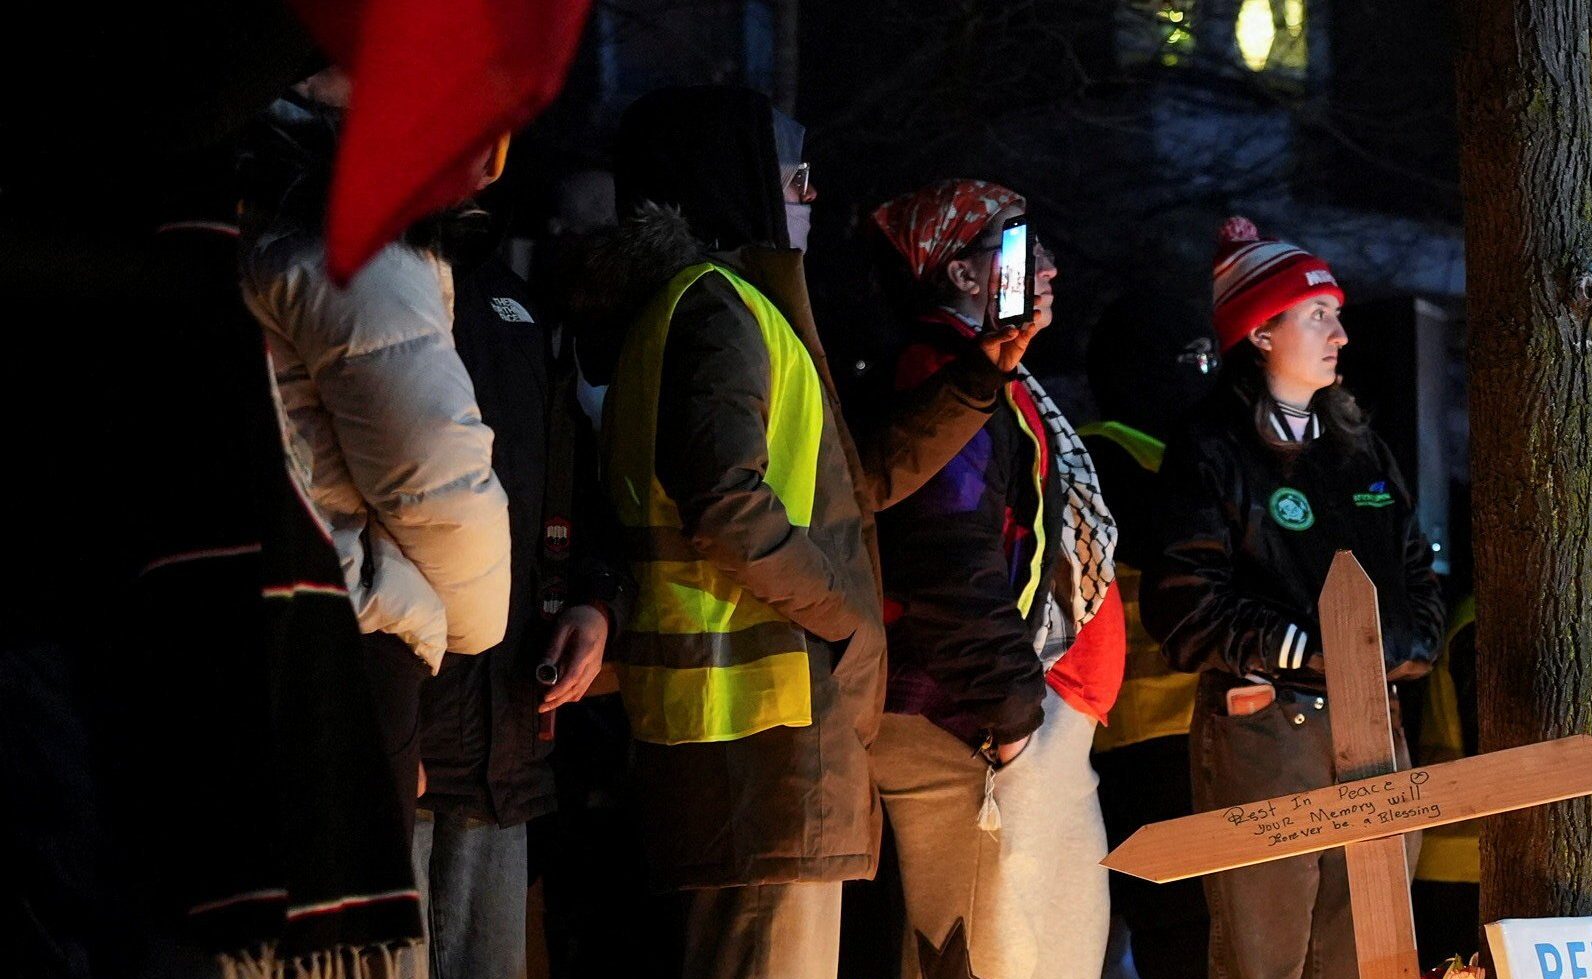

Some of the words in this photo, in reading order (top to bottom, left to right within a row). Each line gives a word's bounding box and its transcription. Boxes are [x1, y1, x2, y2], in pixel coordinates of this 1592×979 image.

[1223, 801, 1277, 826] Rest
[1291, 793, 1312, 810] In
[1338, 781, 1396, 800] Peace
[1310, 800, 1375, 823] Memory
[1387, 785, 1420, 805] will
[1363, 818, 1371, 826] a
[1377, 803, 1441, 823] Blessing
